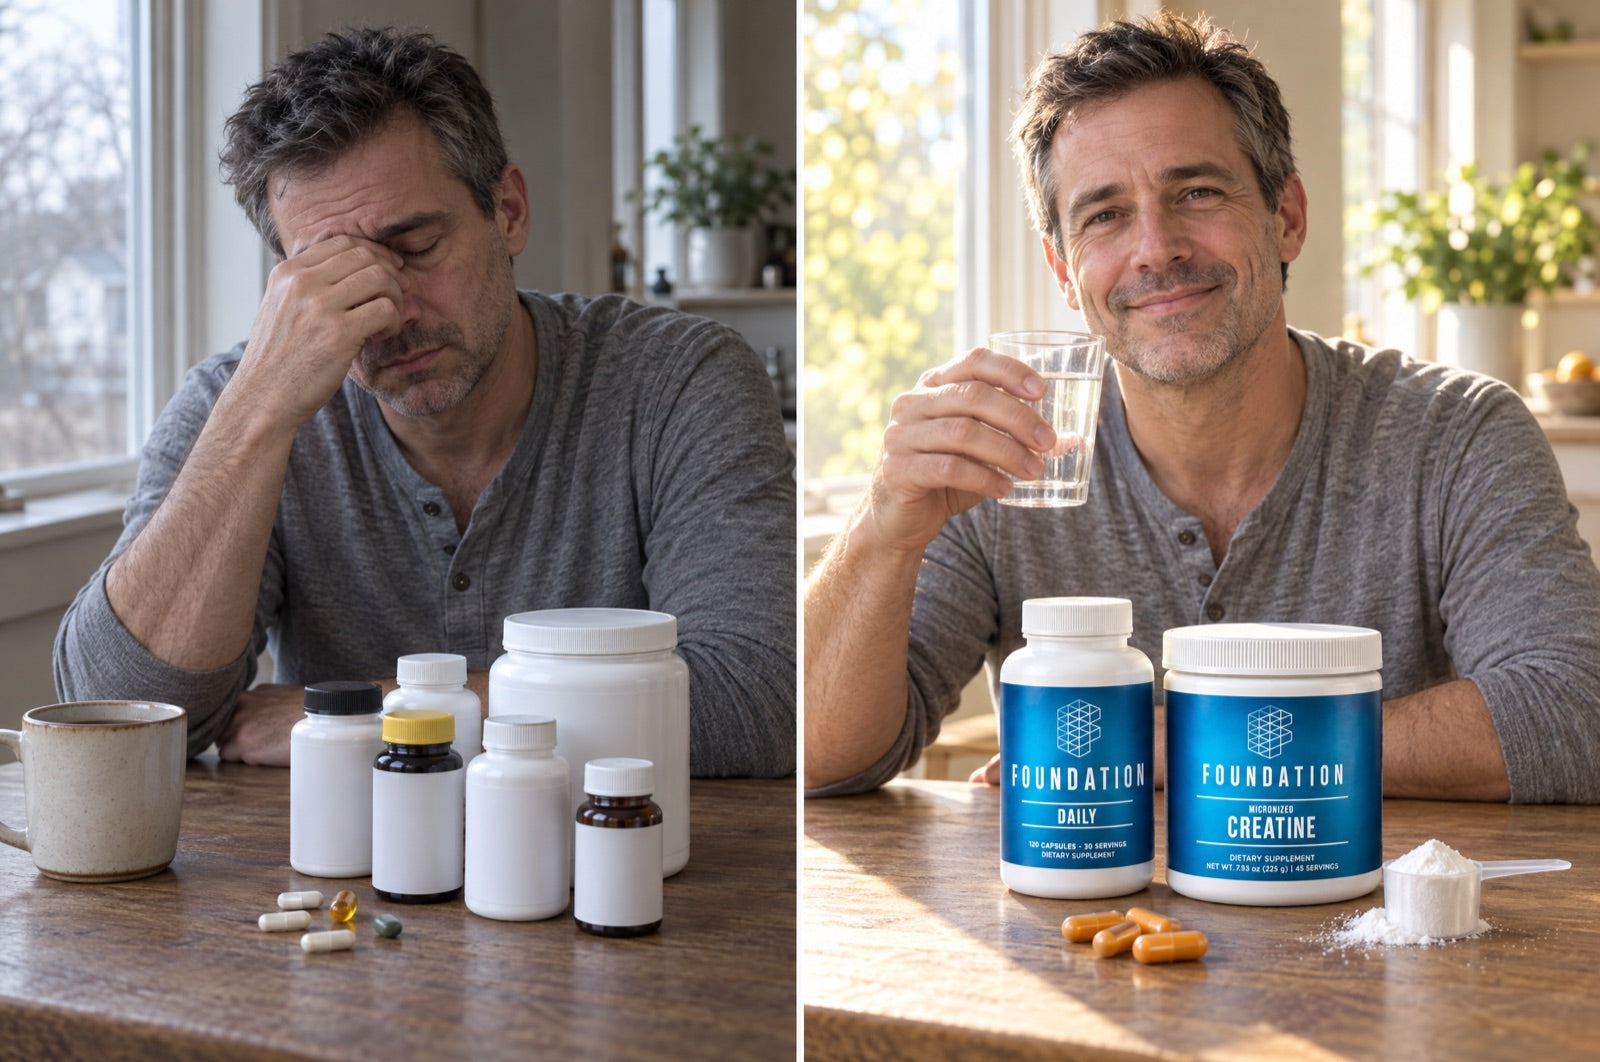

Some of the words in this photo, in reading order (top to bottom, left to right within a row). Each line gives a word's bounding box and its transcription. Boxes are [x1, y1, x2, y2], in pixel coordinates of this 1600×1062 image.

[1011, 763, 1144, 791] FOUNDATION
[1202, 763, 1343, 788] FOUNDATION
[1248, 805, 1294, 814] MICRONIZED
[1057, 808, 1097, 825] DAILY
[1227, 815, 1316, 839] CREATINE
[1028, 840, 1040, 848] 120
[1040, 842, 1077, 850] CAPSULES
[1094, 840, 1128, 850] SERVINGS
[1041, 851, 1070, 859] DIETARY
[1071, 851, 1116, 859] SUPPLEMENT
[1229, 854, 1262, 862] DIETARY
[1264, 854, 1315, 863] SUPPLEMENT
[1206, 862, 1219, 870] NET
[1221, 863, 1235, 872] WT.
[1251, 865, 1260, 873] oz
[1262, 864, 1279, 874] (225
[1280, 865, 1289, 874] g)
[1305, 862, 1339, 871] SERVINGS
